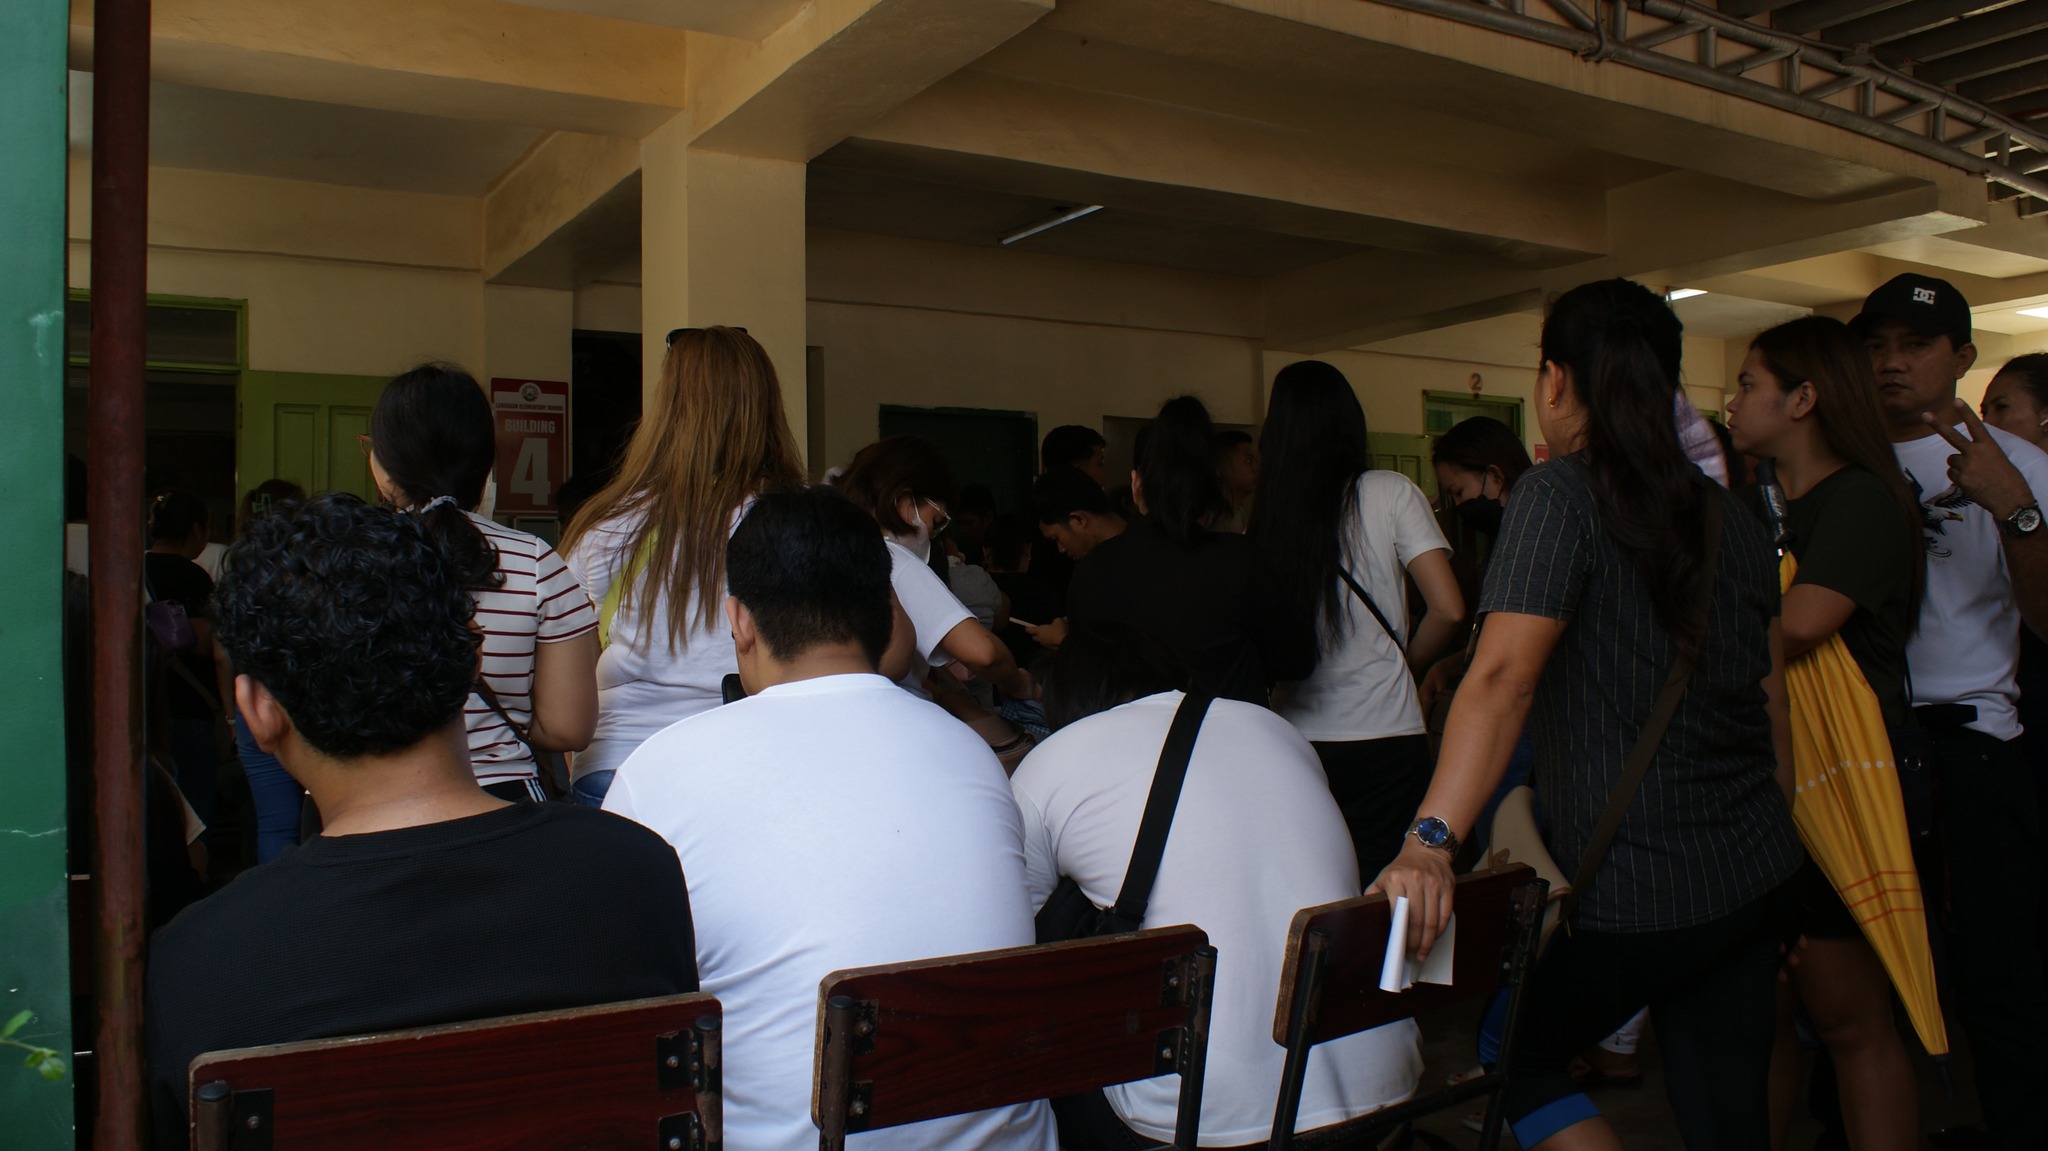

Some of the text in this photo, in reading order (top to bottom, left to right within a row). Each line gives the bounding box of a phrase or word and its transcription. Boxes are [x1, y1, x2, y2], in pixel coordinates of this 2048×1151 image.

[1471, 372, 1482, 391] 2
[505, 419, 556, 434] BUILDING
[510, 437, 551, 506] 4
